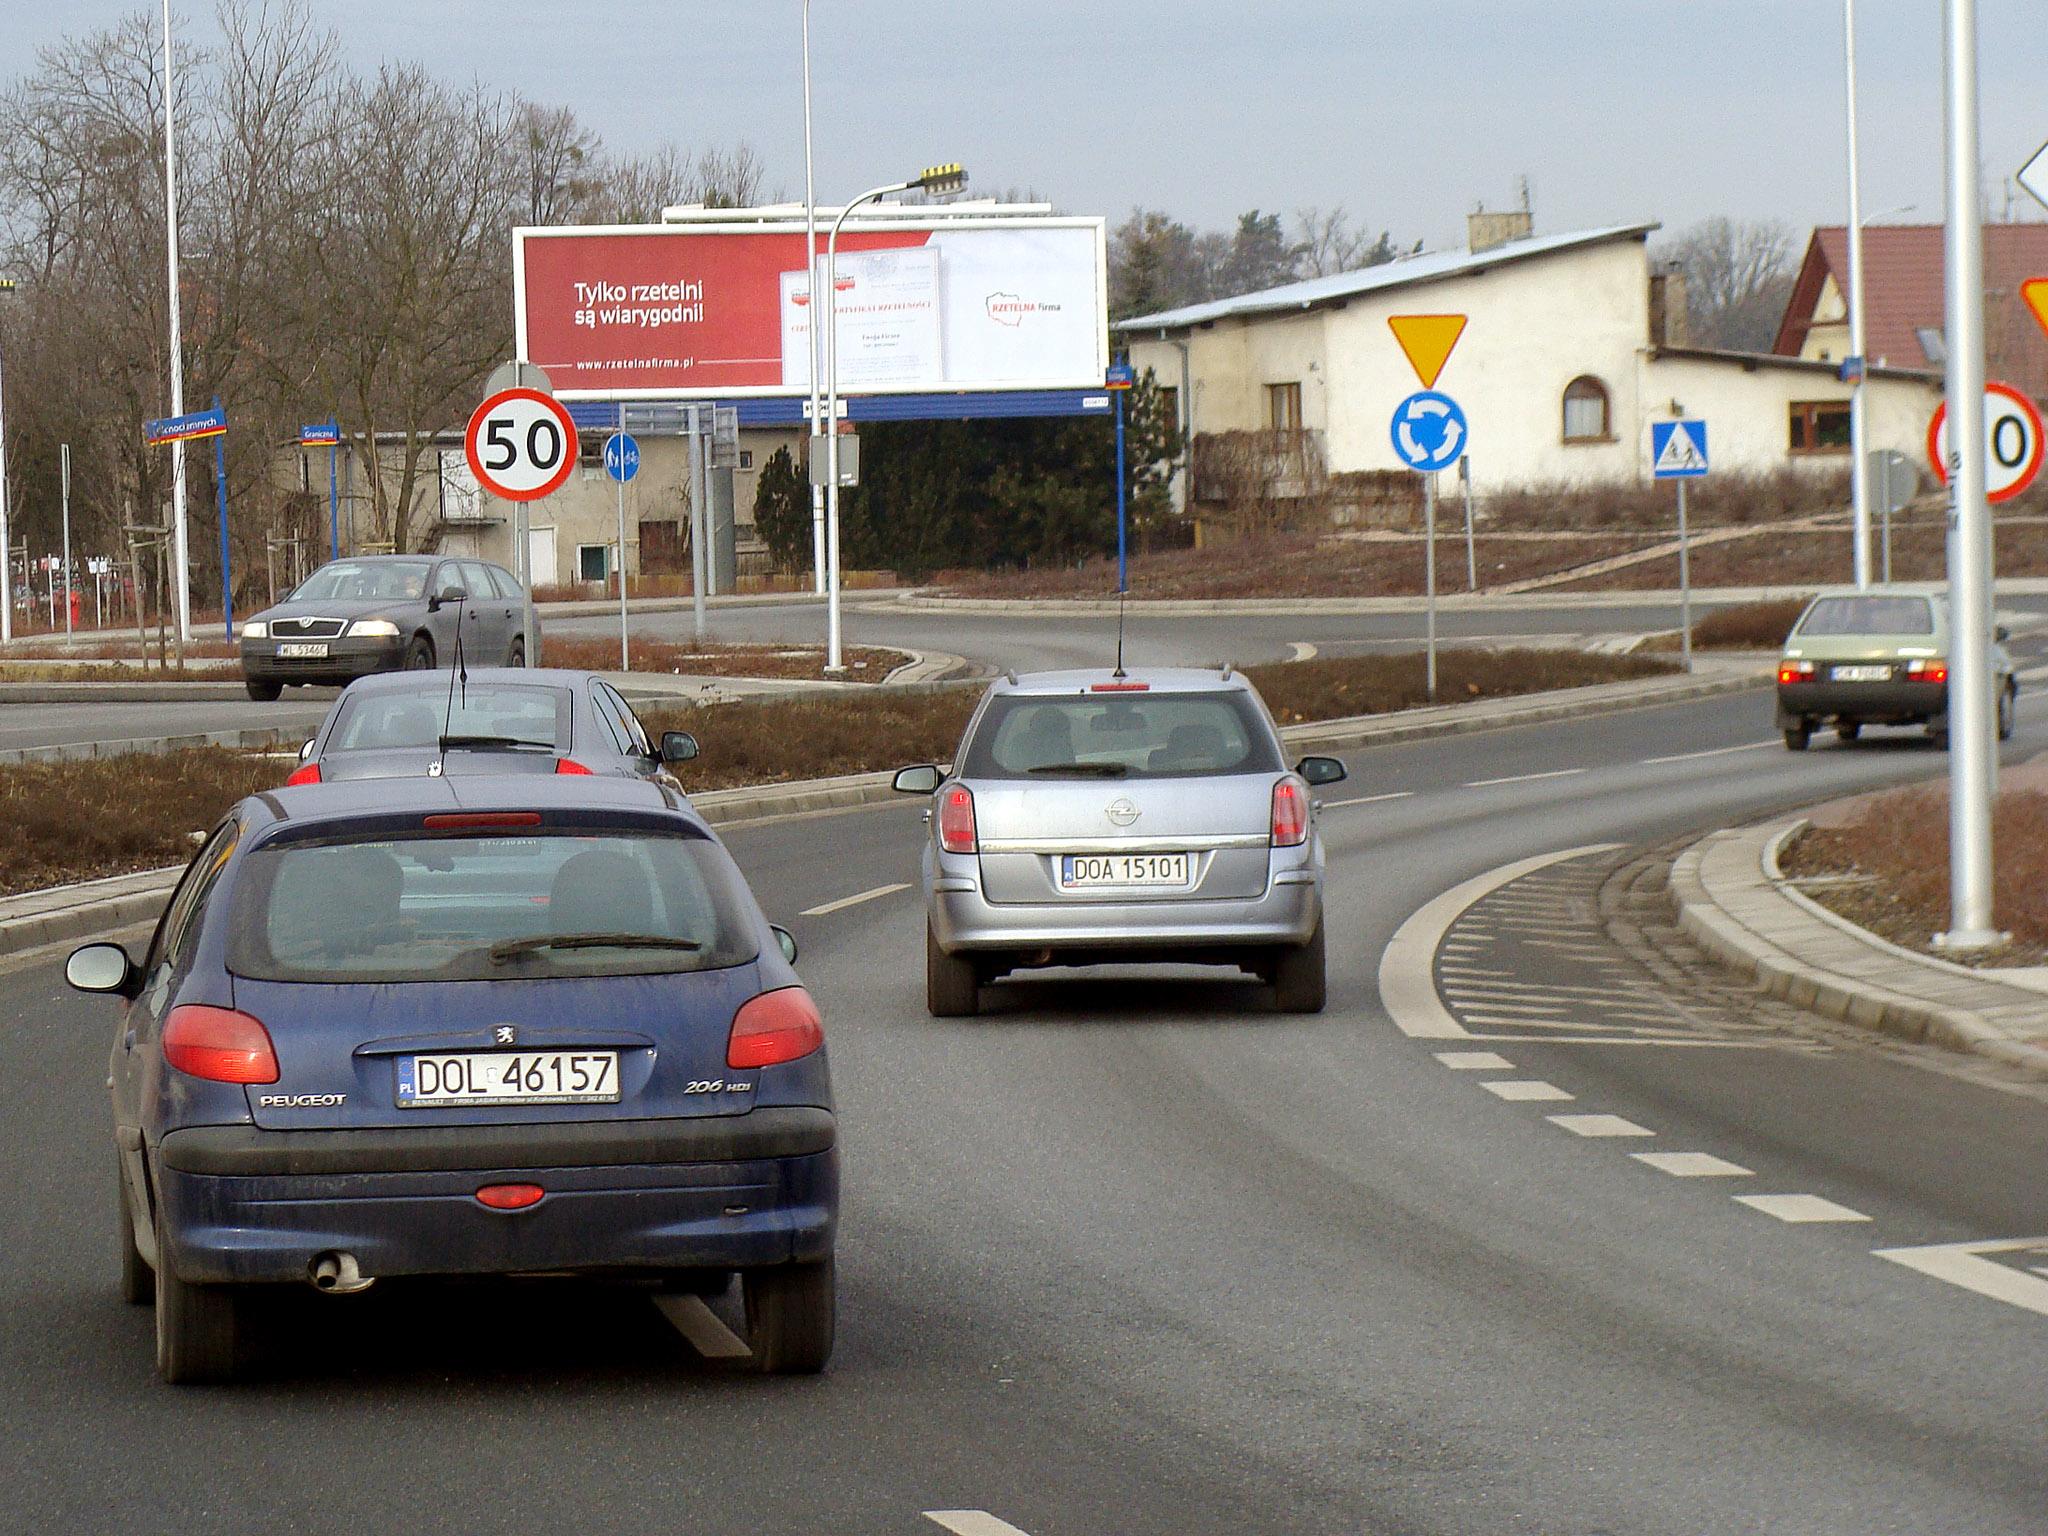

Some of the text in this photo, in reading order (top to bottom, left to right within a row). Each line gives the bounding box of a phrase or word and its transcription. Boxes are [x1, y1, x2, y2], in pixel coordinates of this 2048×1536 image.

[574, 280, 702, 308] Tylko rzetelni
[575, 303, 703, 329] są wiarygodni!
[992, 303, 1036, 313] RZETELNA
[576, 357, 693, 370] www.rzetelnafirma.pl
[157, 417, 217, 434] chocimnych
[485, 418, 561, 471] 50
[1993, 414, 2026, 468] 0
[1075, 857, 1181, 879] DOA 15101
[418, 1055, 612, 1095] DOL 46157
[400, 1083, 414, 1094] PL
[683, 1079, 724, 1094] 206
[260, 1093, 347, 1107] PEUGEOT
